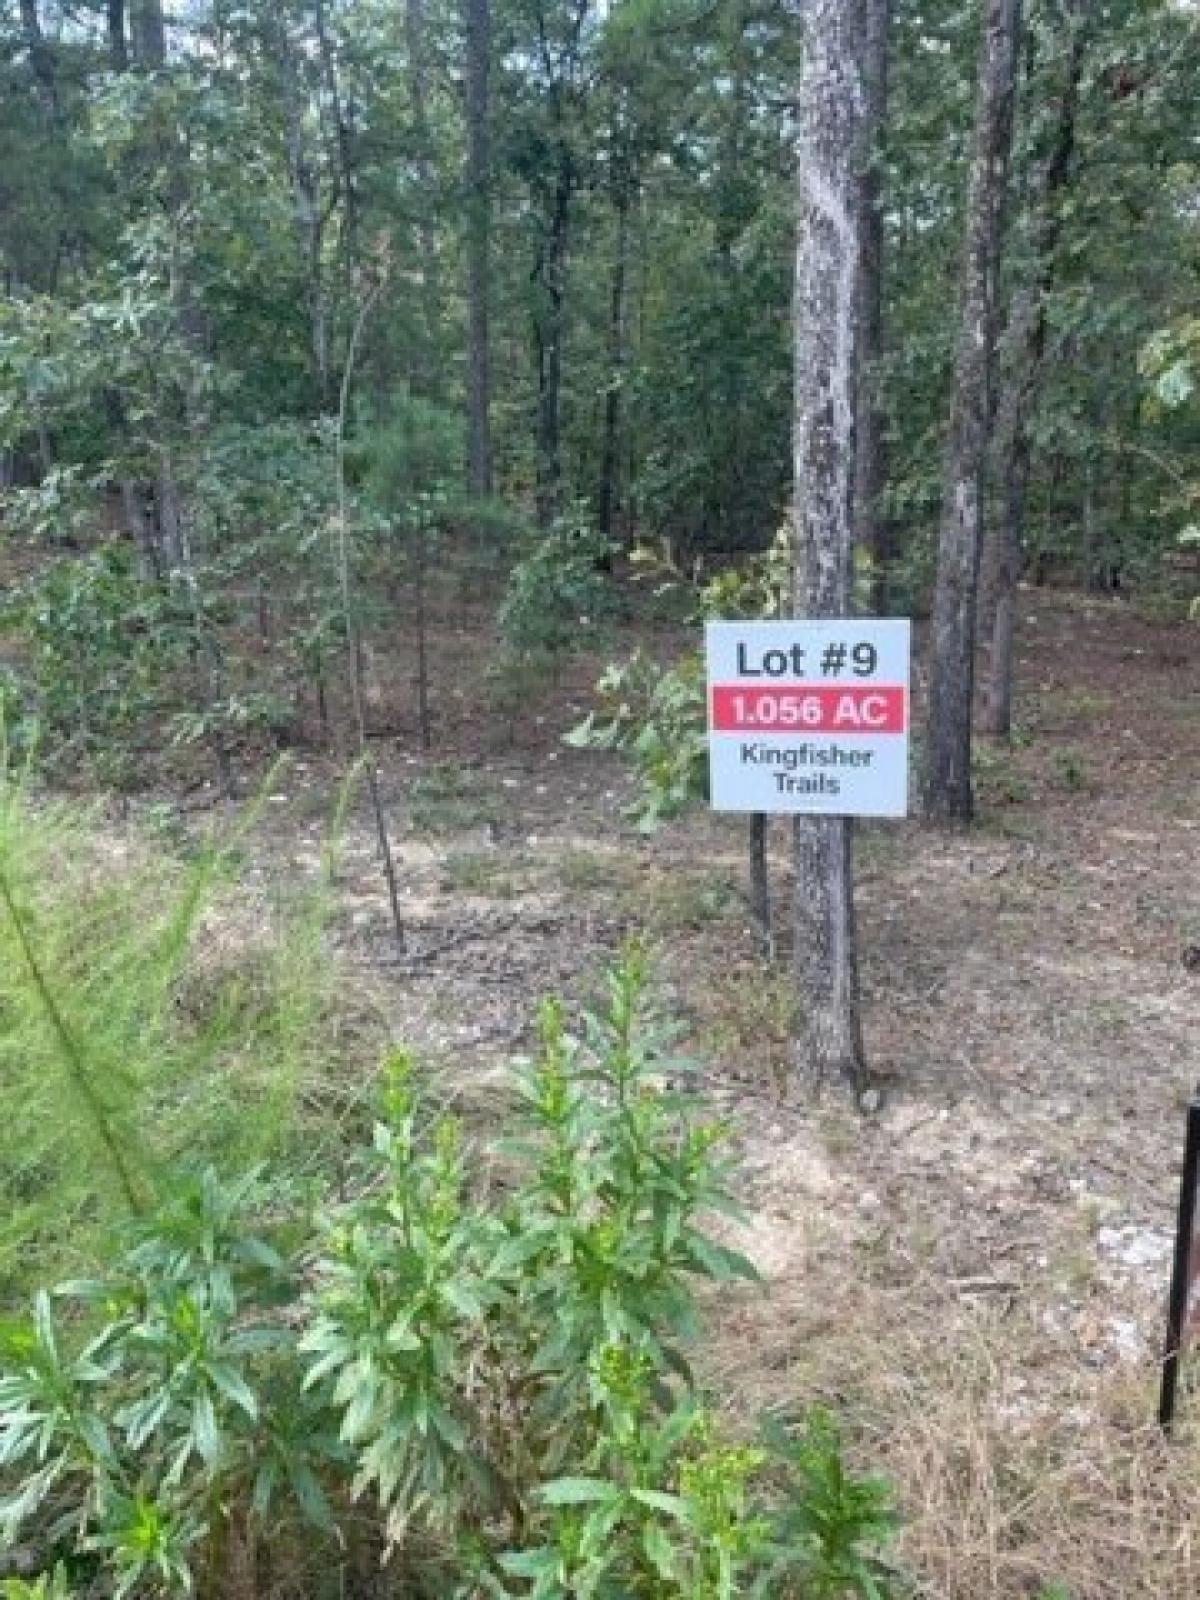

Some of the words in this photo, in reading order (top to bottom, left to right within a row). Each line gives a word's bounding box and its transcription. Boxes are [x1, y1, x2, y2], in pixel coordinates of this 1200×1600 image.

[737, 642, 806, 677] Lot
[820, 642, 878, 677] #9
[732, 695, 823, 724] 1.056
[833, 695, 888, 724] AC
[740, 743, 873, 770] Kingfisher
[773, 772, 841, 794] Trails
